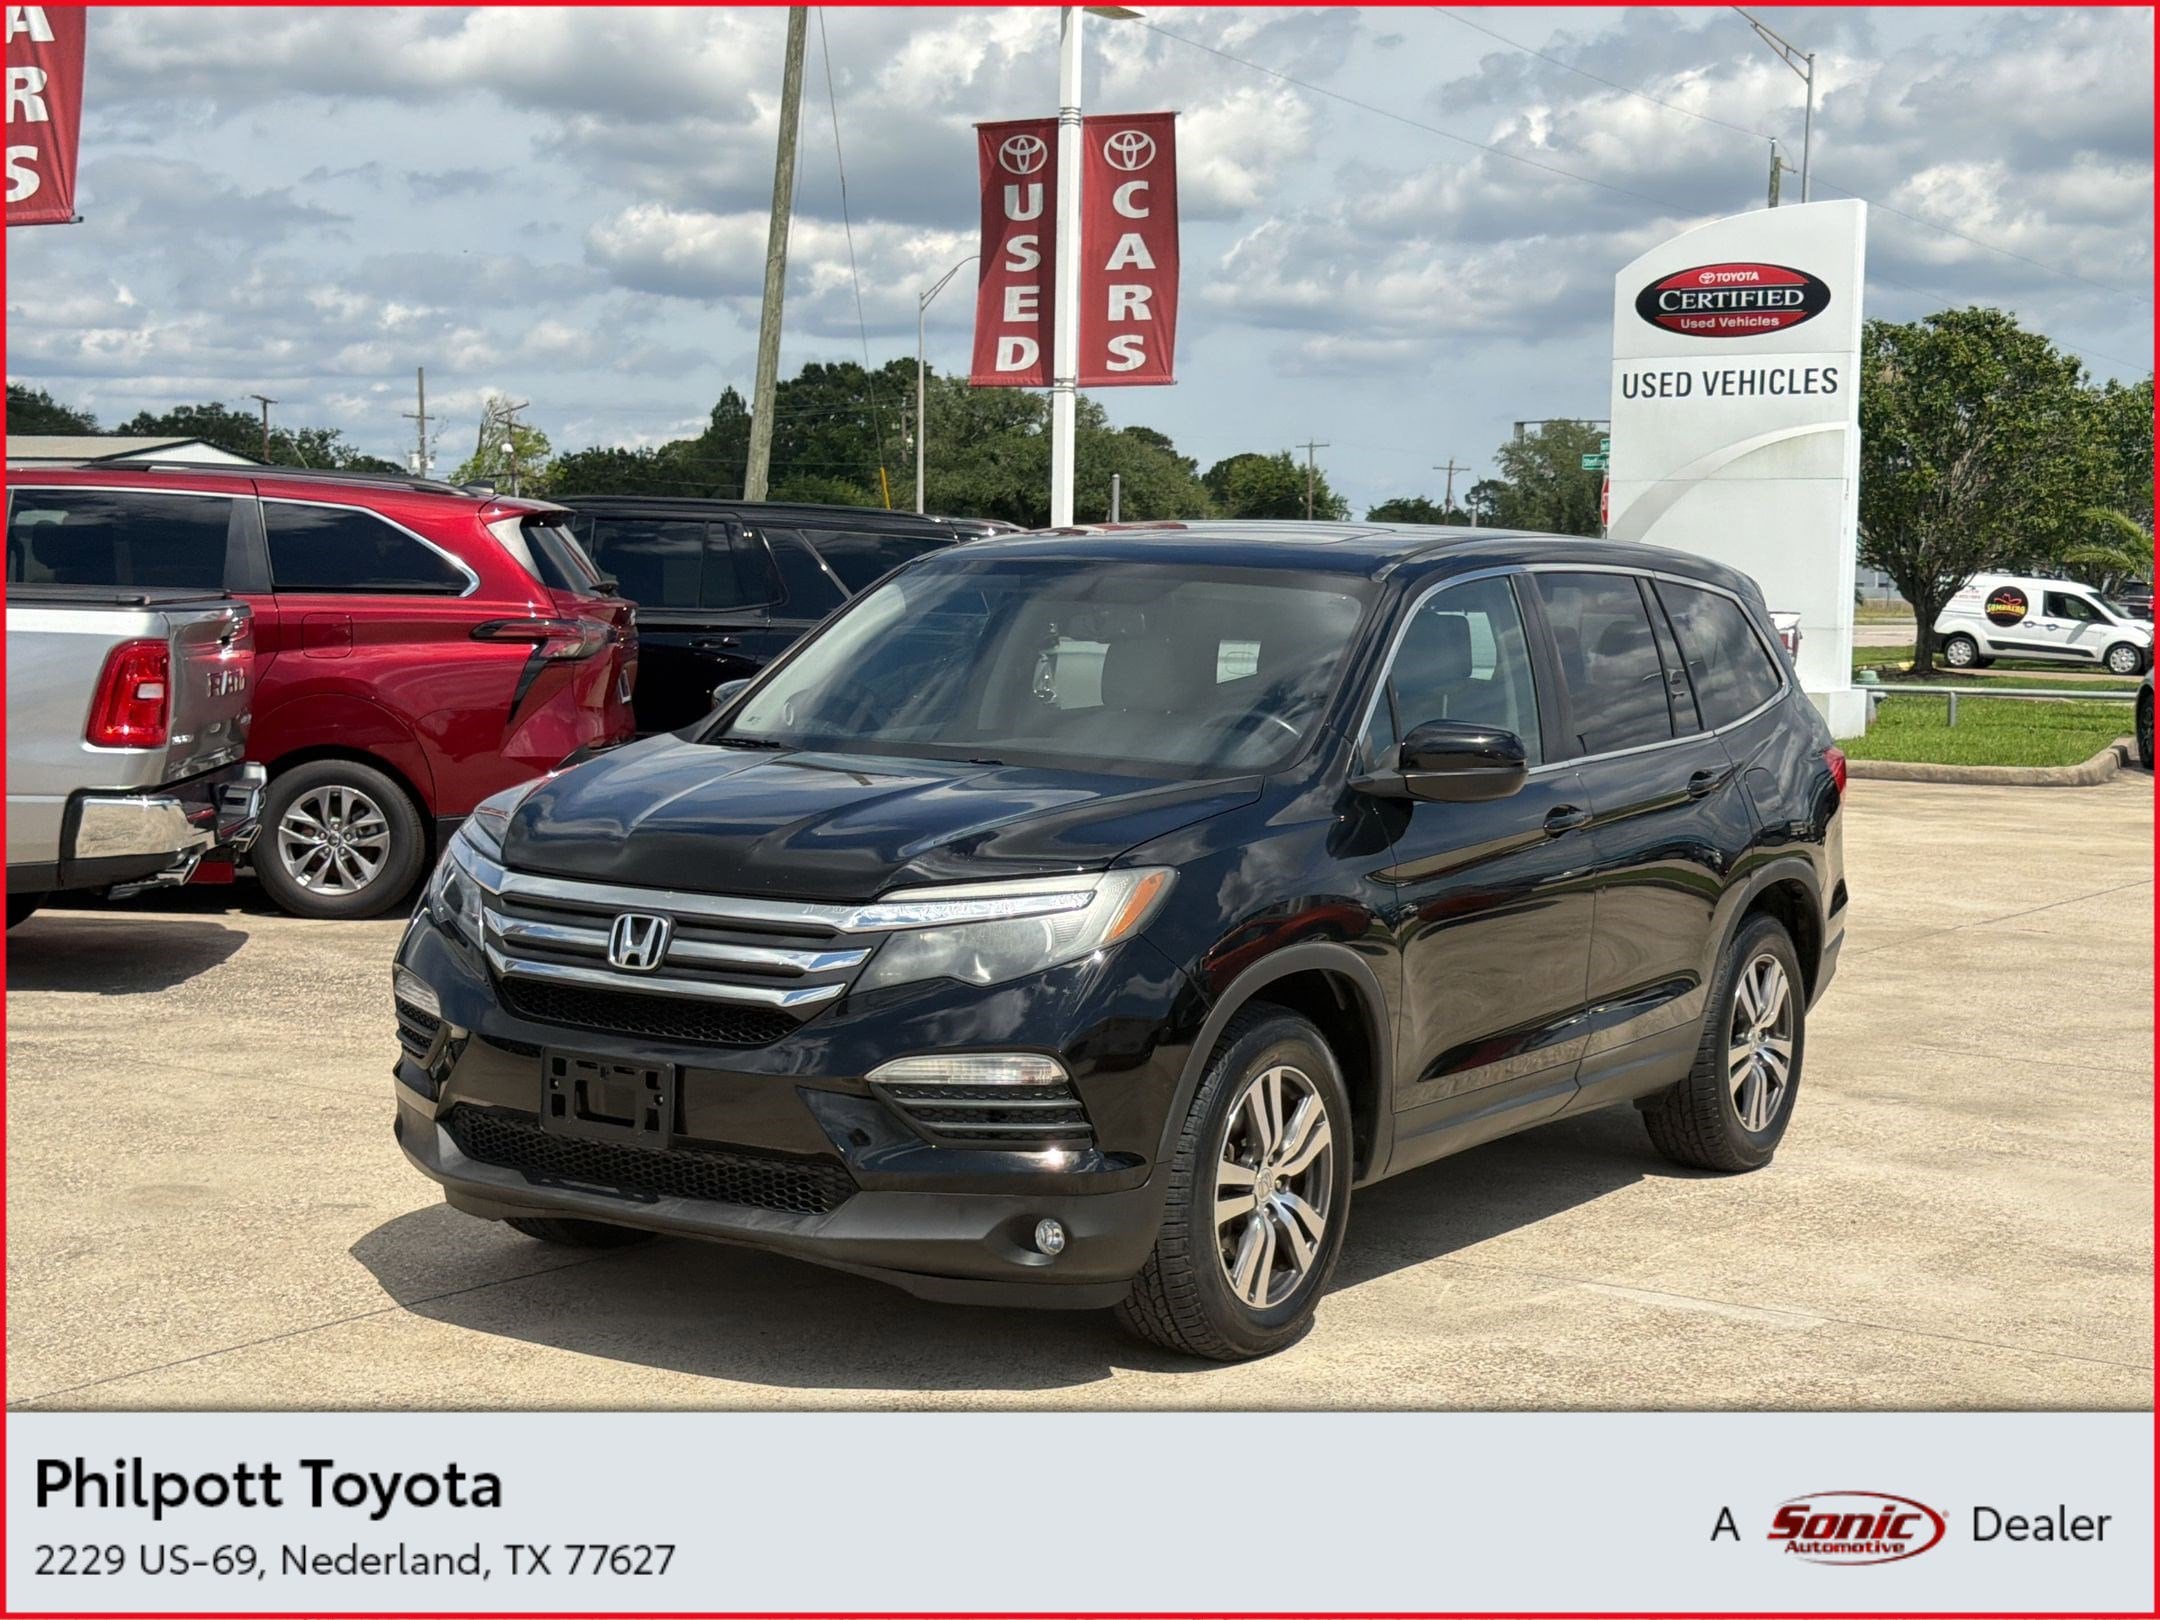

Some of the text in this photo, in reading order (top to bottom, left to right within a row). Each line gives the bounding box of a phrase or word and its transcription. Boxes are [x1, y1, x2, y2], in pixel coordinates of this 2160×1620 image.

[995, 182, 1044, 372] USED
[1104, 180, 1157, 372] CARS
[1714, 271, 1760, 283] TOYOTA
[1658, 289, 1805, 312] CERTIFIED
[1680, 315, 1780, 330] Used Vehicles
[1622, 367, 1839, 399] USED VEHICLES
